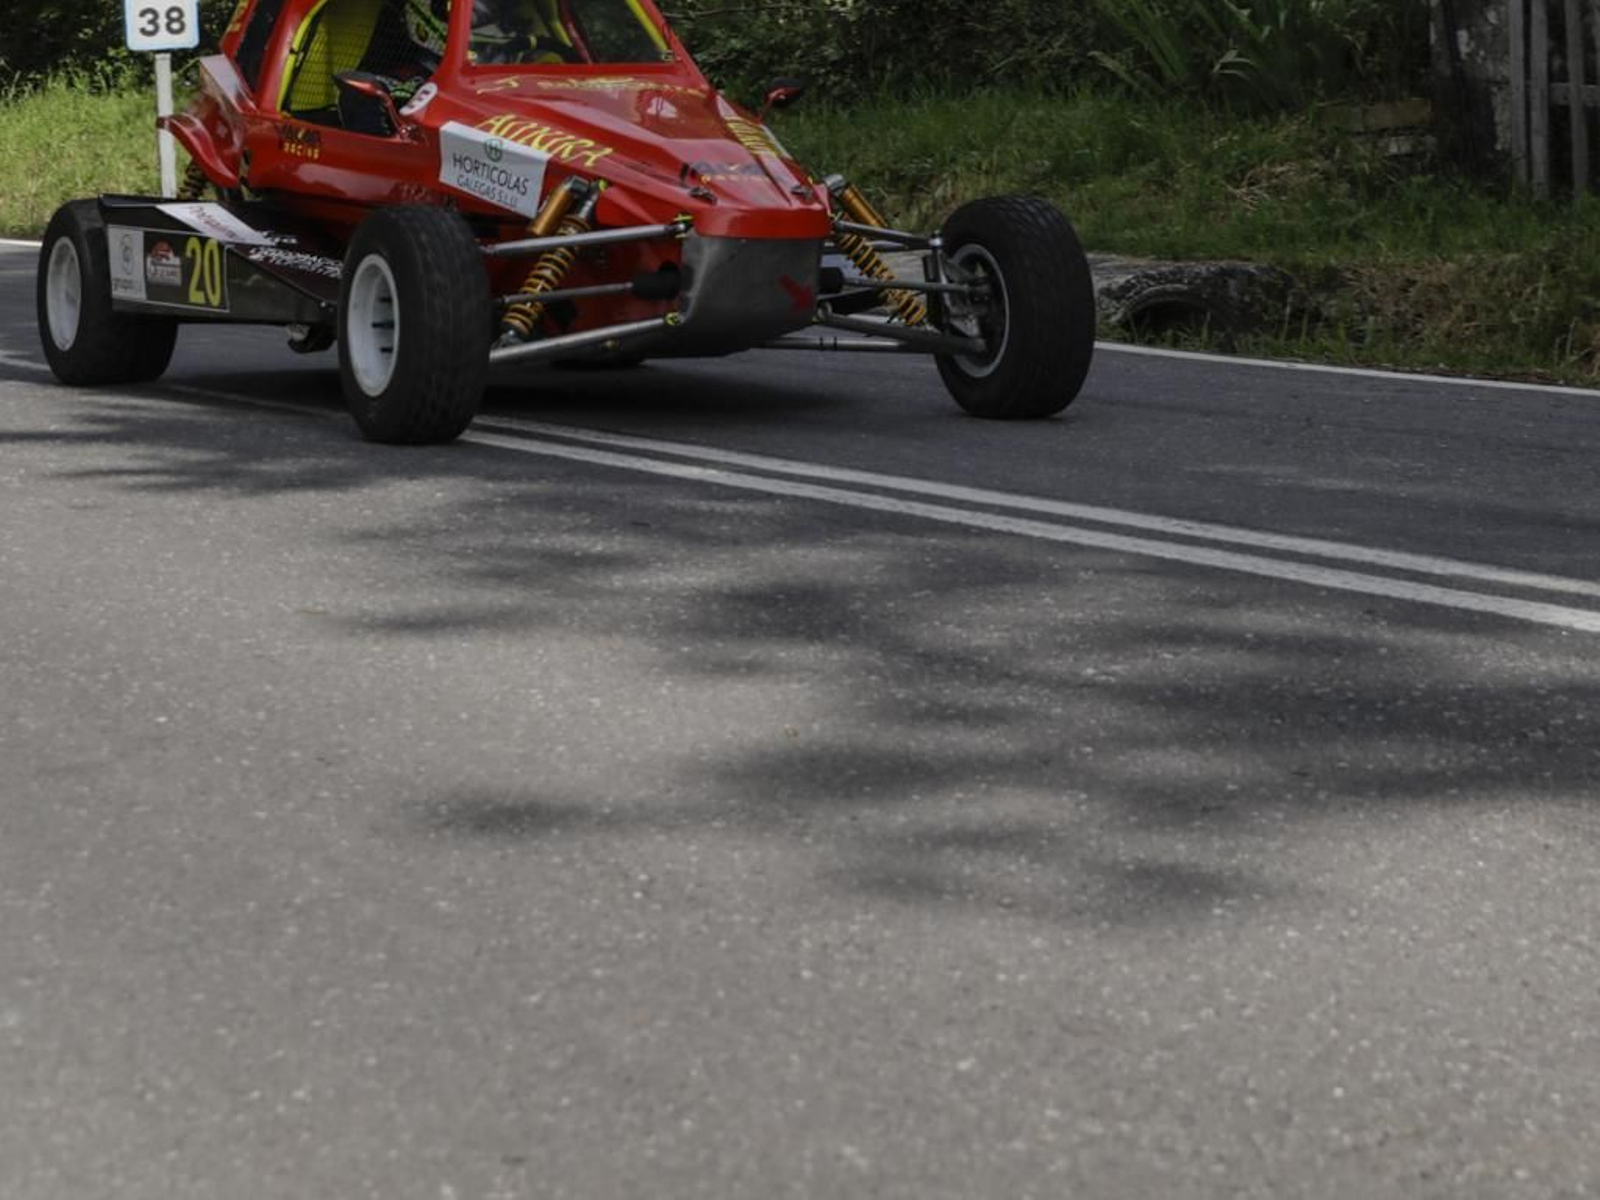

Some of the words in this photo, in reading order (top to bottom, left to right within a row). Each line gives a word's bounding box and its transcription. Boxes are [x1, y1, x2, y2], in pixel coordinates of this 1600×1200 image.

[138, 5, 187, 38] 38
[451, 151, 530, 196] HORTICOLAS
[185, 236, 222, 307] 20
